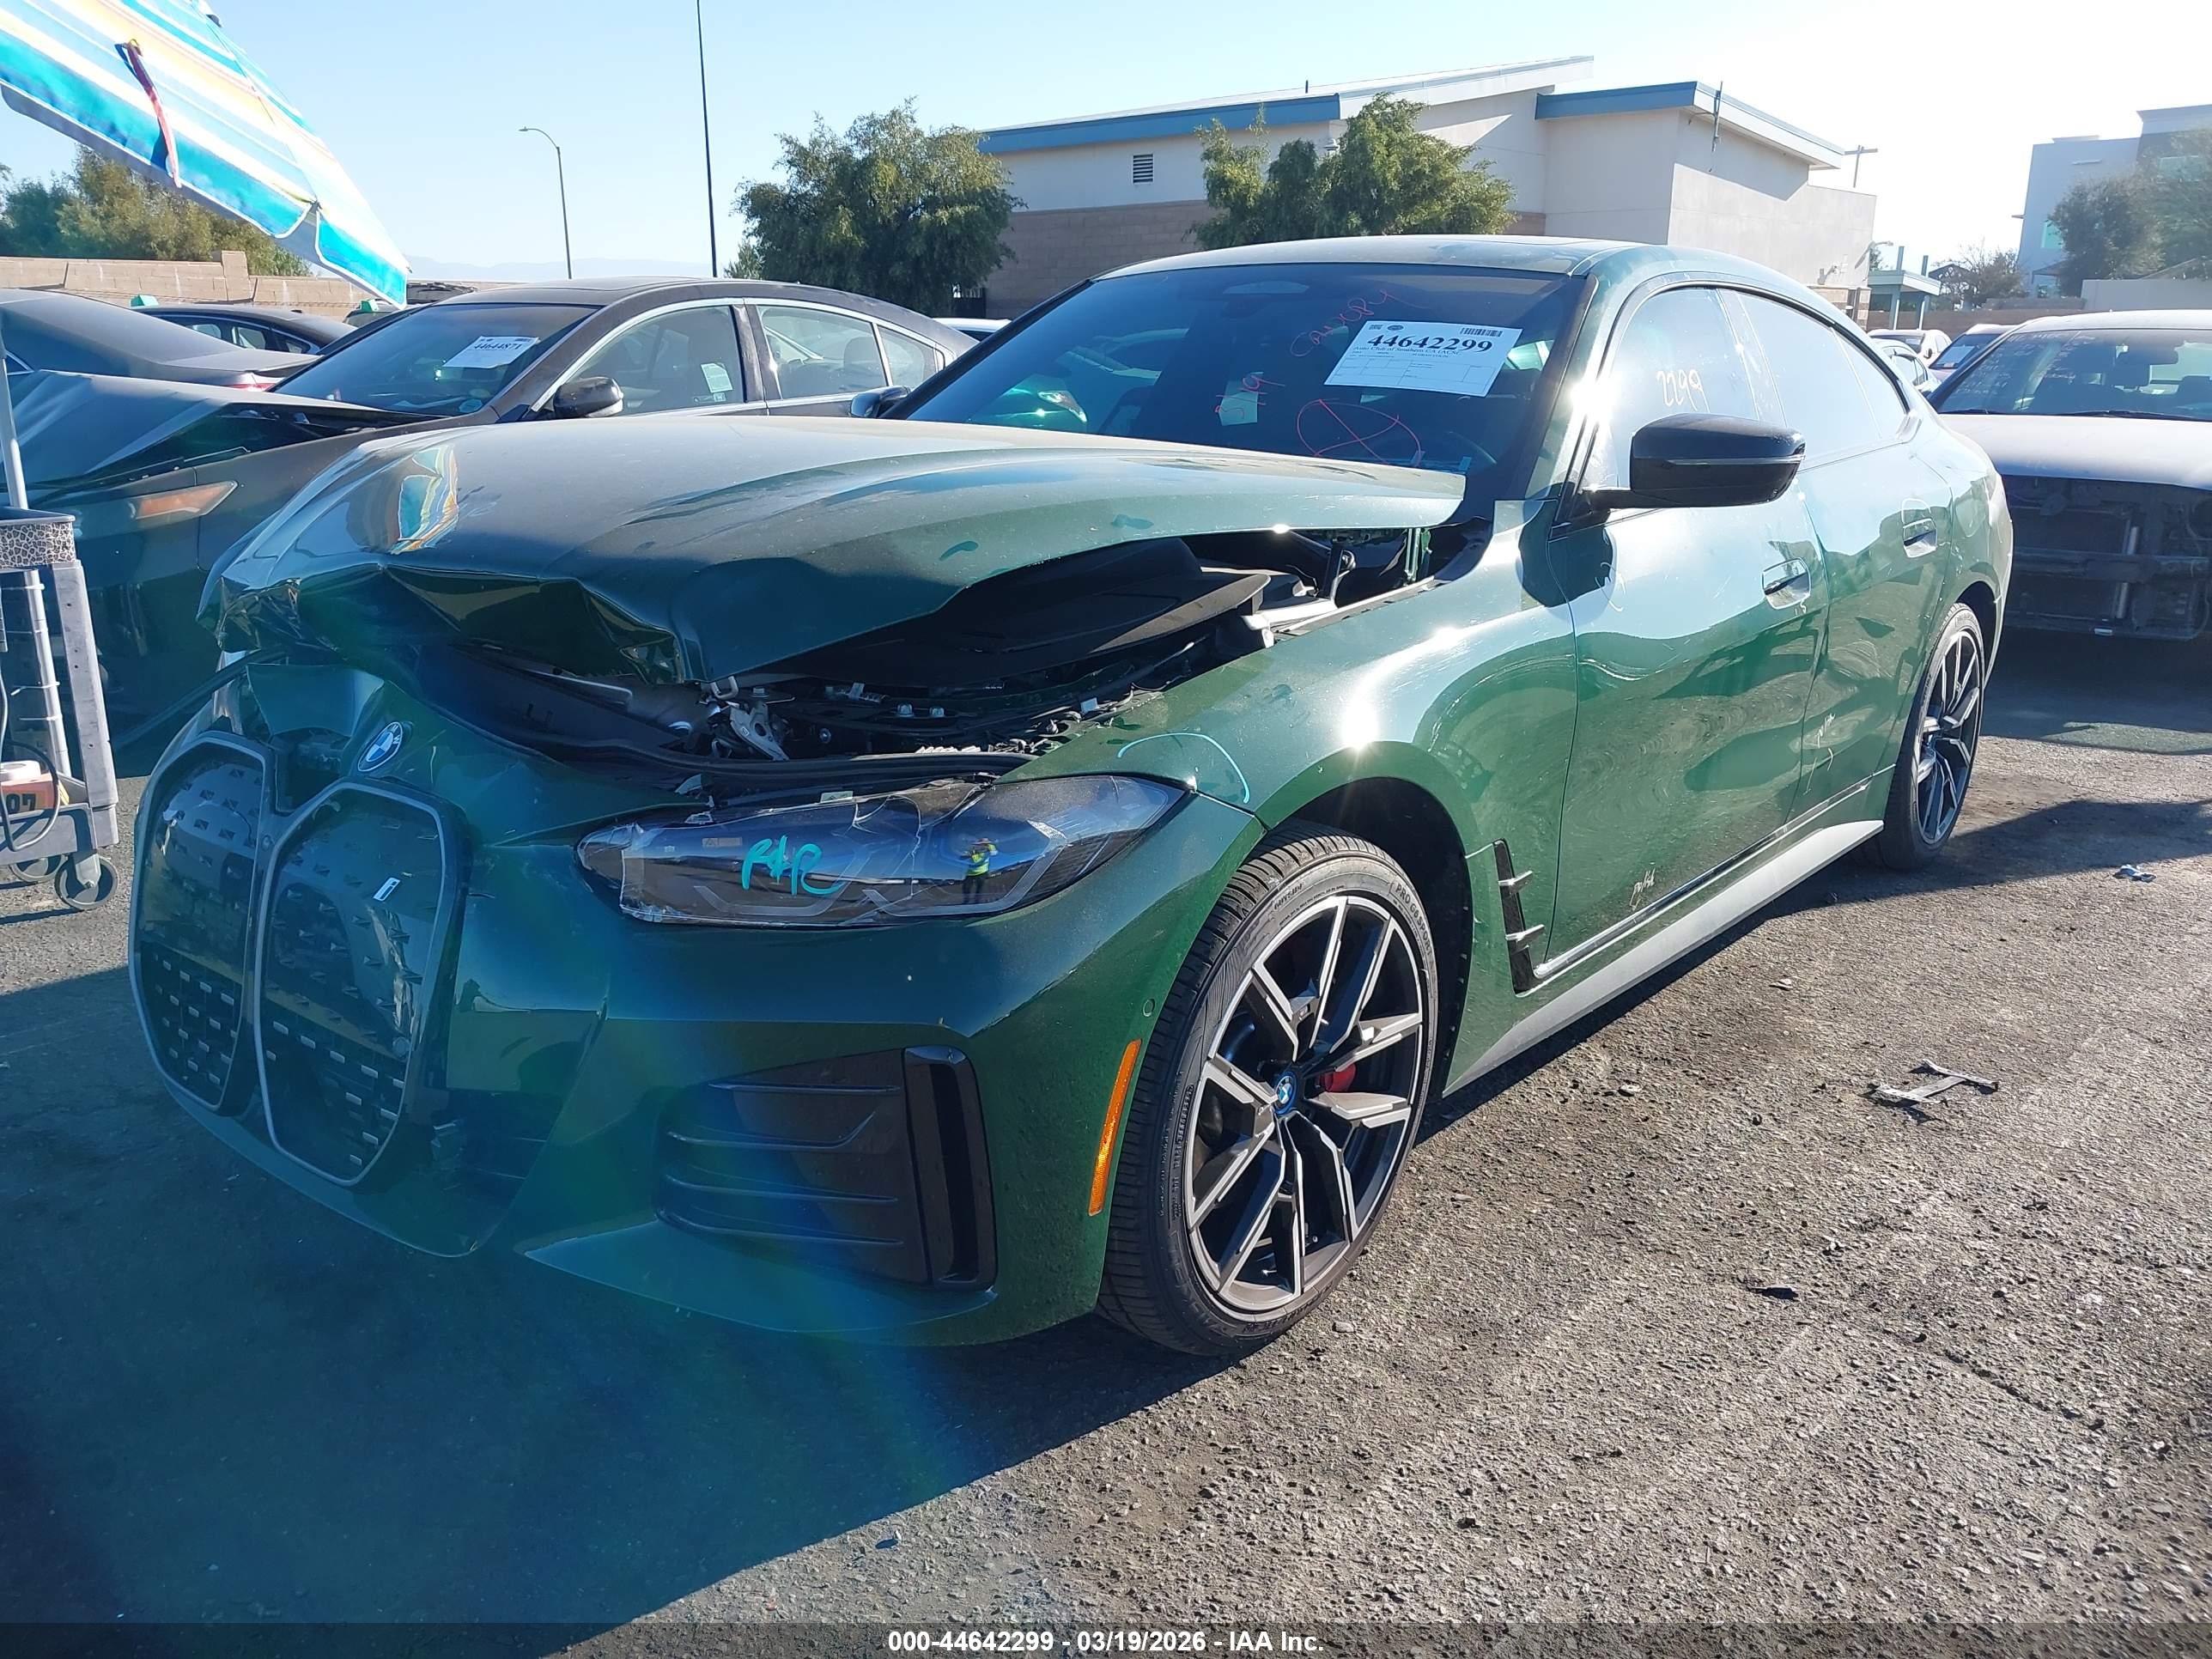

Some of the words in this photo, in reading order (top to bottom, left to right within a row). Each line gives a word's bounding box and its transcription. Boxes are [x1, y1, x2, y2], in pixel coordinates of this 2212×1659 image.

[1368, 334, 1492, 353] 44642299
[1395, 883, 1411, 904] PRO
[1417, 916, 1432, 955] SPORT
